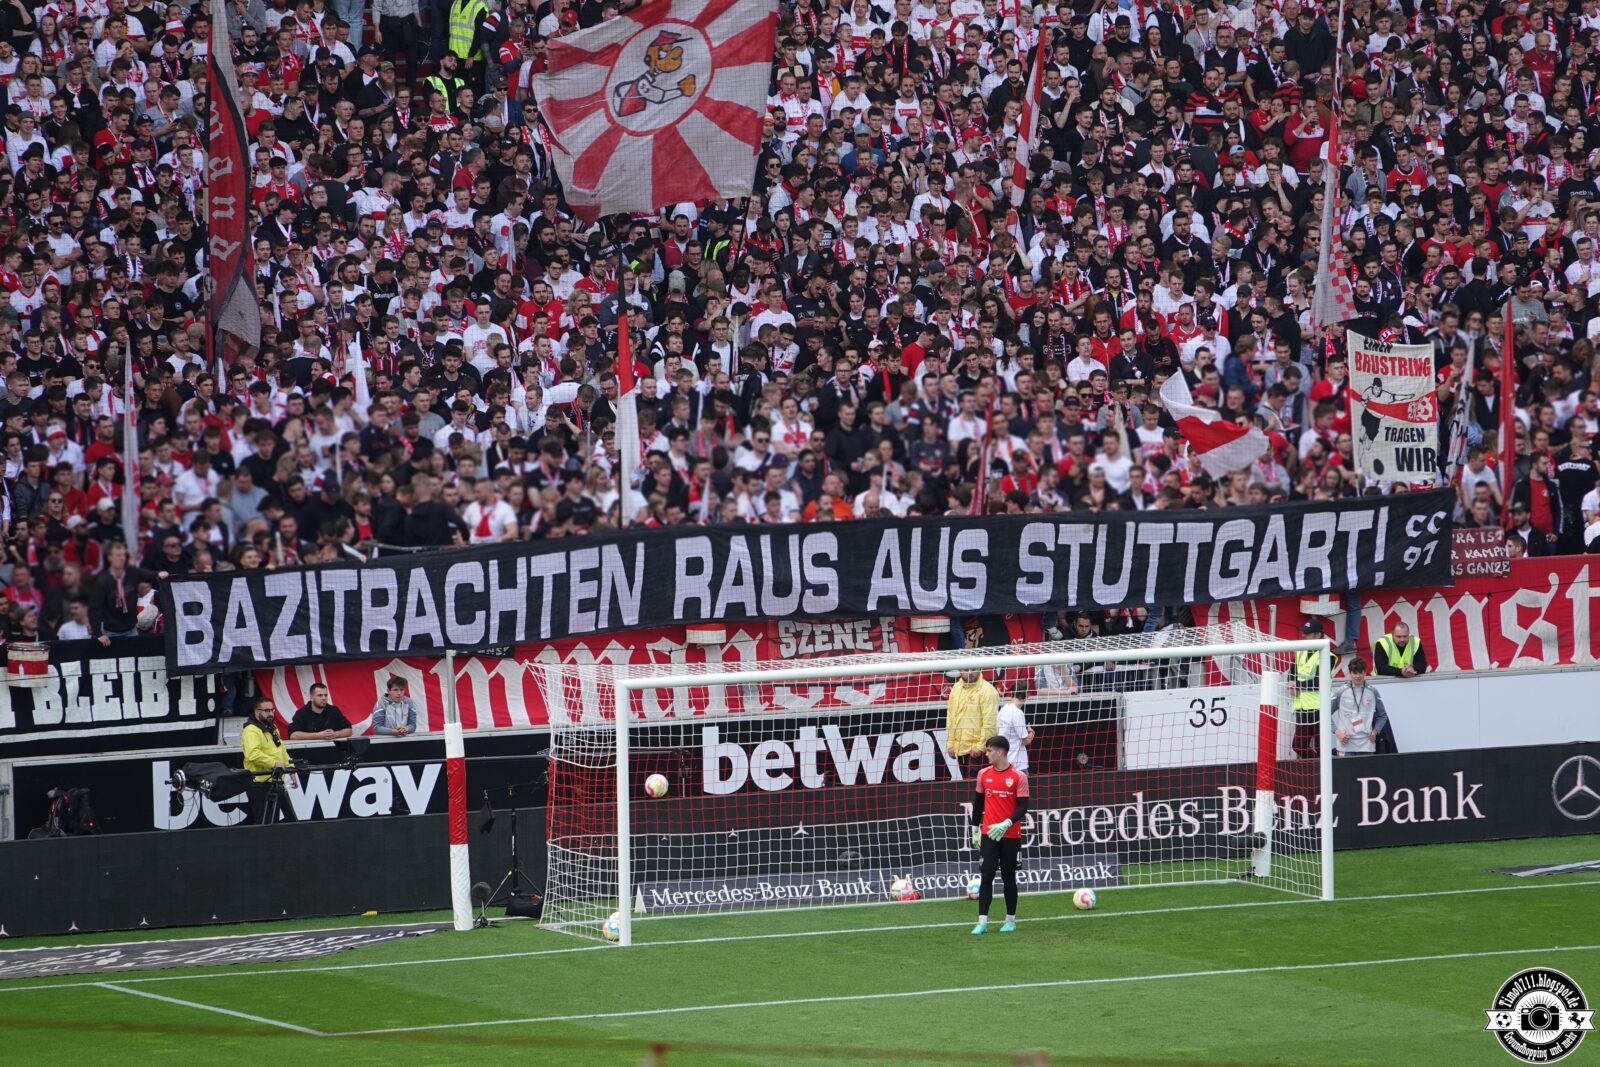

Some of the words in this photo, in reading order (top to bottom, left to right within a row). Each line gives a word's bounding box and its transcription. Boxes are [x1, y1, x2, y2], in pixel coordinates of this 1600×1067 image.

[1364, 338, 1393, 354] EINEN
[1354, 351, 1432, 377] BRUSTRING
[1384, 427, 1426, 443] TRAGEN
[1395, 447, 1436, 472] WIR
[1405, 511, 1447, 538] CC
[1403, 540, 1439, 571] 97
[1466, 561, 1510, 575] GANZE
[170, 541, 645, 667] BAZITRACHTEN
[673, 531, 839, 620] RAUS
[867, 527, 989, 612] AUS
[1015, 506, 1389, 606] STUTTGART!
[777, 620, 875, 658] SZENE
[32, 655, 215, 725] BLEIBT!
[1189, 697, 1228, 728] 35
[152, 760, 442, 831] beway
[1357, 771, 1486, 827] Bank
[1058, 862, 1114, 882] Bank
[651, 882, 813, 908] Mercedes-Benz
[816, 877, 875, 899] Bank
